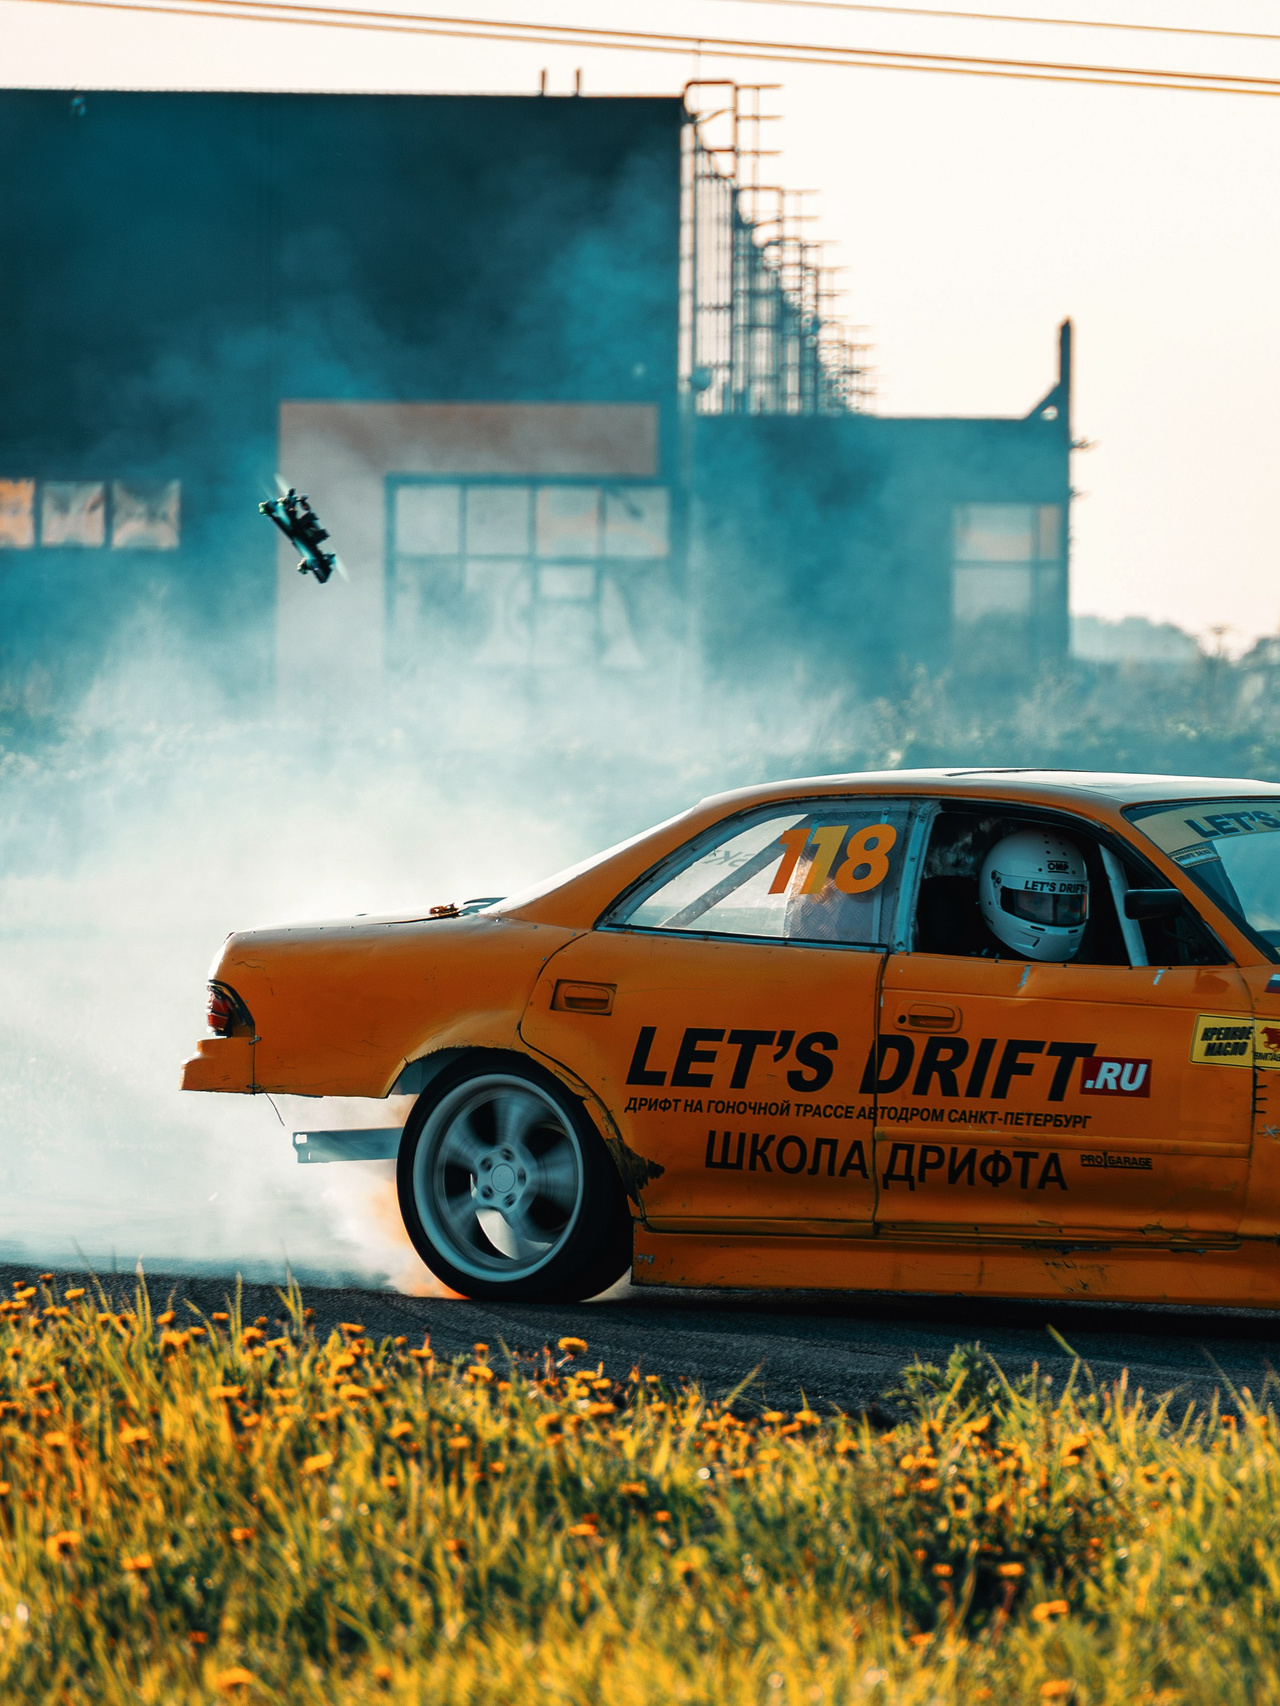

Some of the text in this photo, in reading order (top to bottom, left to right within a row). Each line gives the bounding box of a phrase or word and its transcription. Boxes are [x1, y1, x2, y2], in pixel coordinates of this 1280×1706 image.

[767, 823, 897, 895] 118
[1047, 862, 1070, 872] OMP
[1024, 880, 1086, 894] LET'S DRIFT
[625, 1026, 1149, 1102] LET'S DRIFT .RU
[624, 1097, 1092, 1129] ДРИФТ НА ГОНОЧНОЙ ТРАССЕ АВТОДРОМ САНКТ-ПЕТЕРБУРГ
[704, 1130, 1069, 1191] ШКОЛА ДРИФТА
